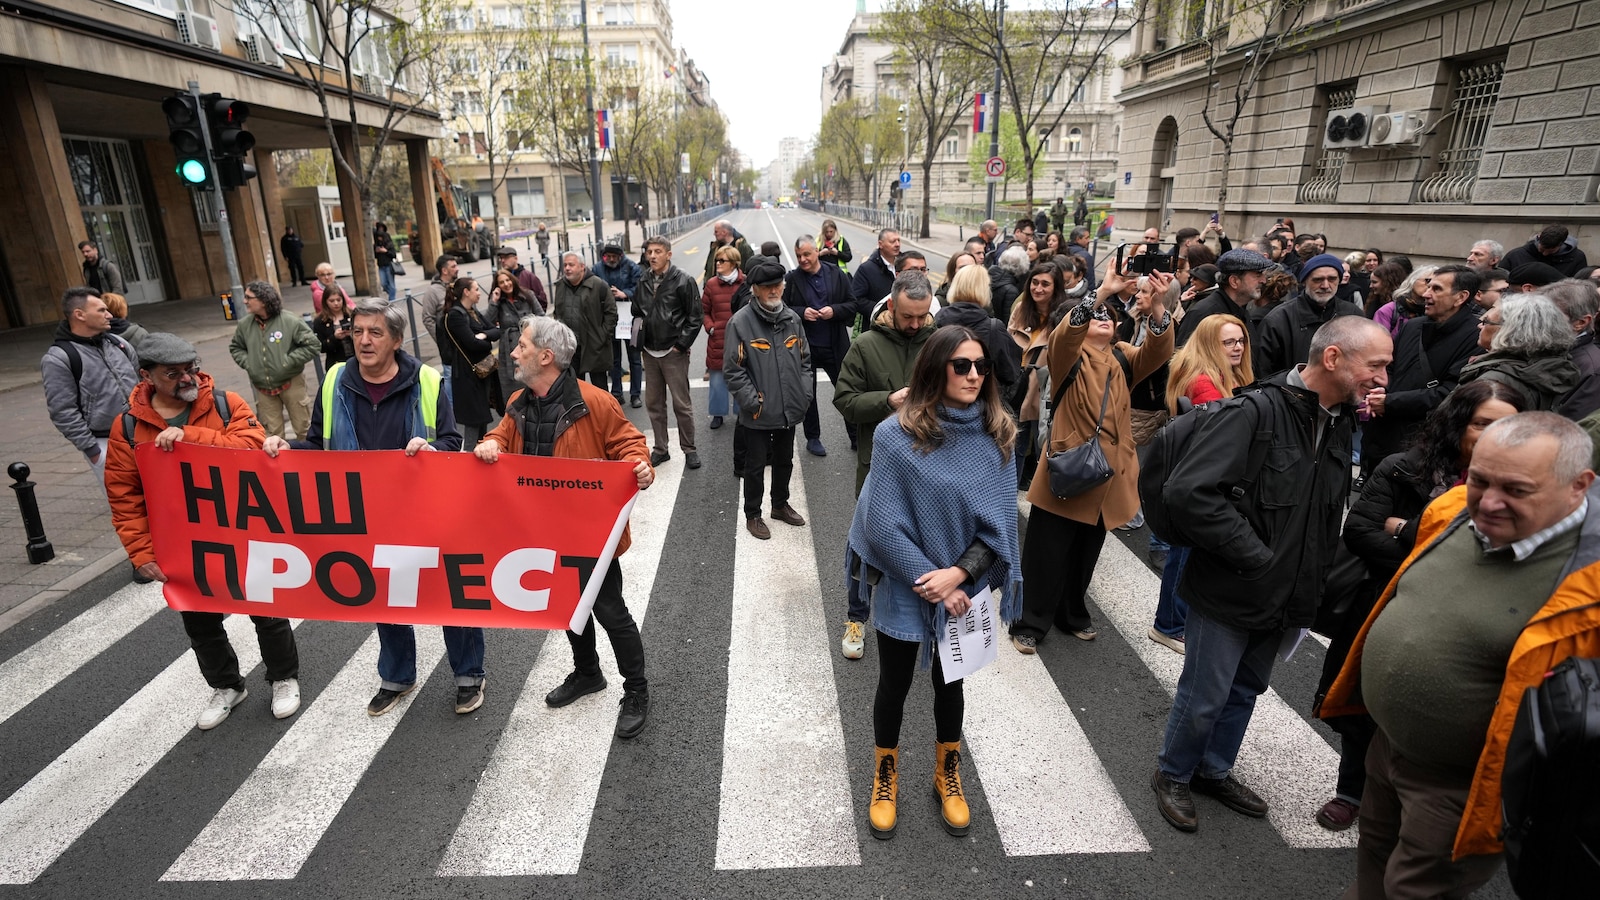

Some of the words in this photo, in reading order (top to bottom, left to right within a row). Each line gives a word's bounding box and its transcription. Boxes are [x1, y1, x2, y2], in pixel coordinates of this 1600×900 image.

[517, 476, 604, 491] #nasprotest
[180, 462, 367, 535] НАШ
[191, 540, 599, 612] ПРОТЕСТ
[980, 601, 989, 617] NE
[966, 609, 976, 633] ŠLEM
[982, 617, 992, 635] IDE
[949, 627, 963, 663] OUTFIT
[984, 635, 992, 649] MI
